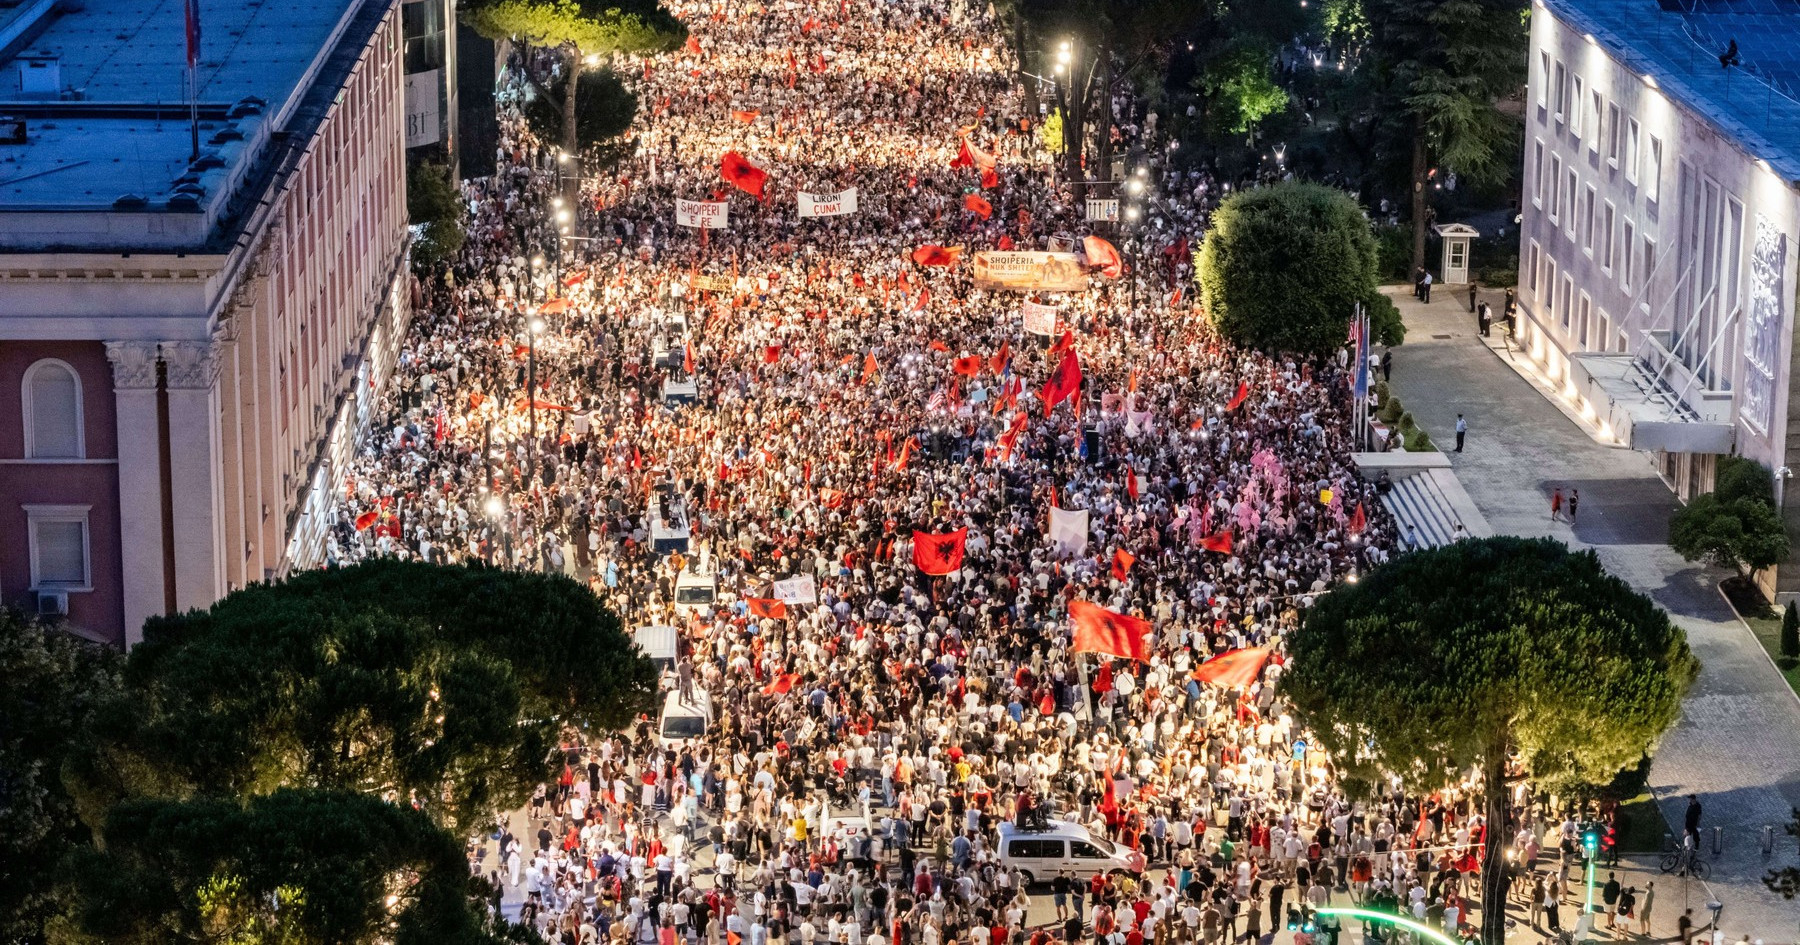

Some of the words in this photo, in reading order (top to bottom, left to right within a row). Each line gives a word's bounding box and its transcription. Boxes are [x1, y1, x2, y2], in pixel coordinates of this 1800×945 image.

[813, 194, 841, 202] LIRONI
[814, 203, 841, 215] ÇUNAT
[690, 216, 696, 225] E
[701, 217, 712, 227] RE
